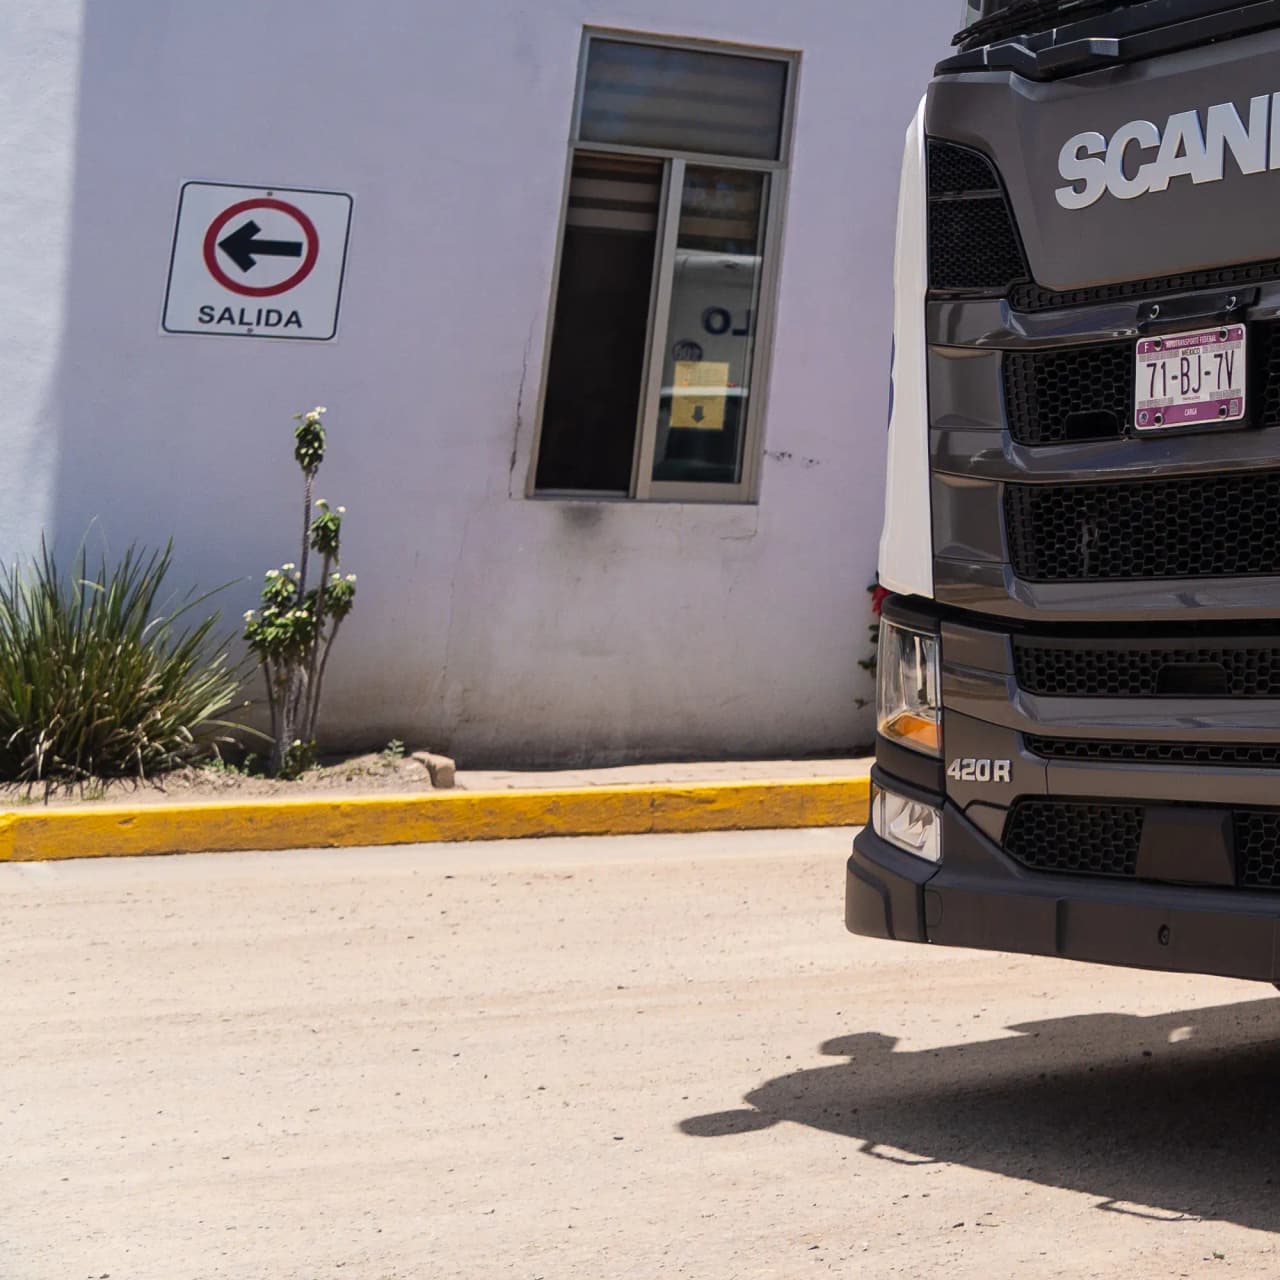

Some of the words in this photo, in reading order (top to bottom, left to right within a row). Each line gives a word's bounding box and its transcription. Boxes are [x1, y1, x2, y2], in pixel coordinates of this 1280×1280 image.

[197, 305, 302, 329] SALIDA
[1146, 350, 1234, 398] 71-BJ-7V
[947, 758, 991, 781] 420
[994, 759, 1010, 783] R
